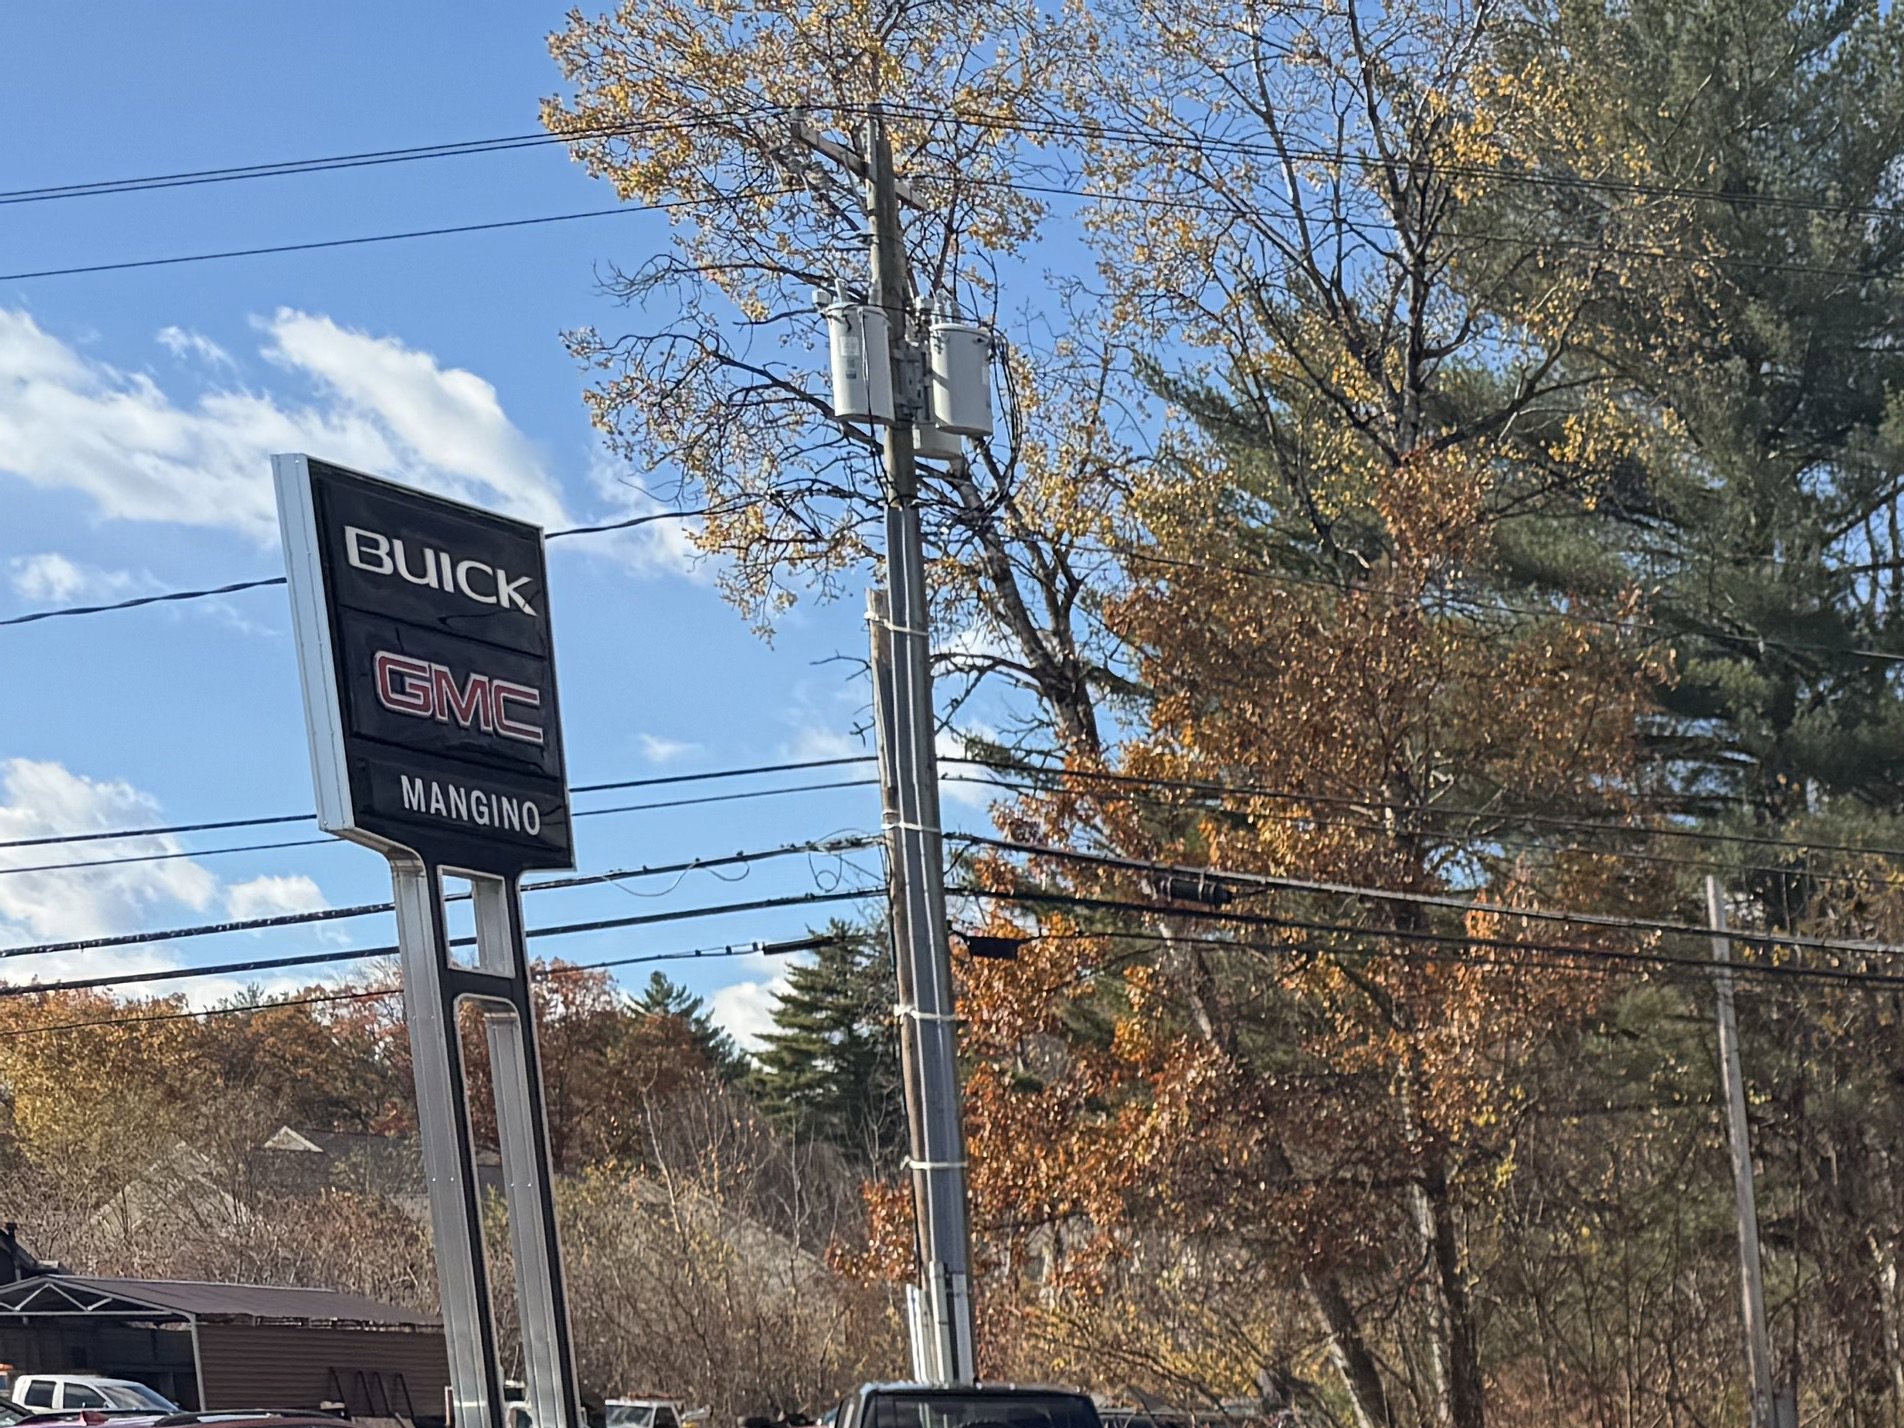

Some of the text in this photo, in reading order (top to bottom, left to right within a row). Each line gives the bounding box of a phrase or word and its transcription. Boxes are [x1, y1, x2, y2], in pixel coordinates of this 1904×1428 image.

[344, 525, 537, 617] BUICK
[374, 650, 544, 744] GMC
[400, 774, 541, 836] MANGINO
